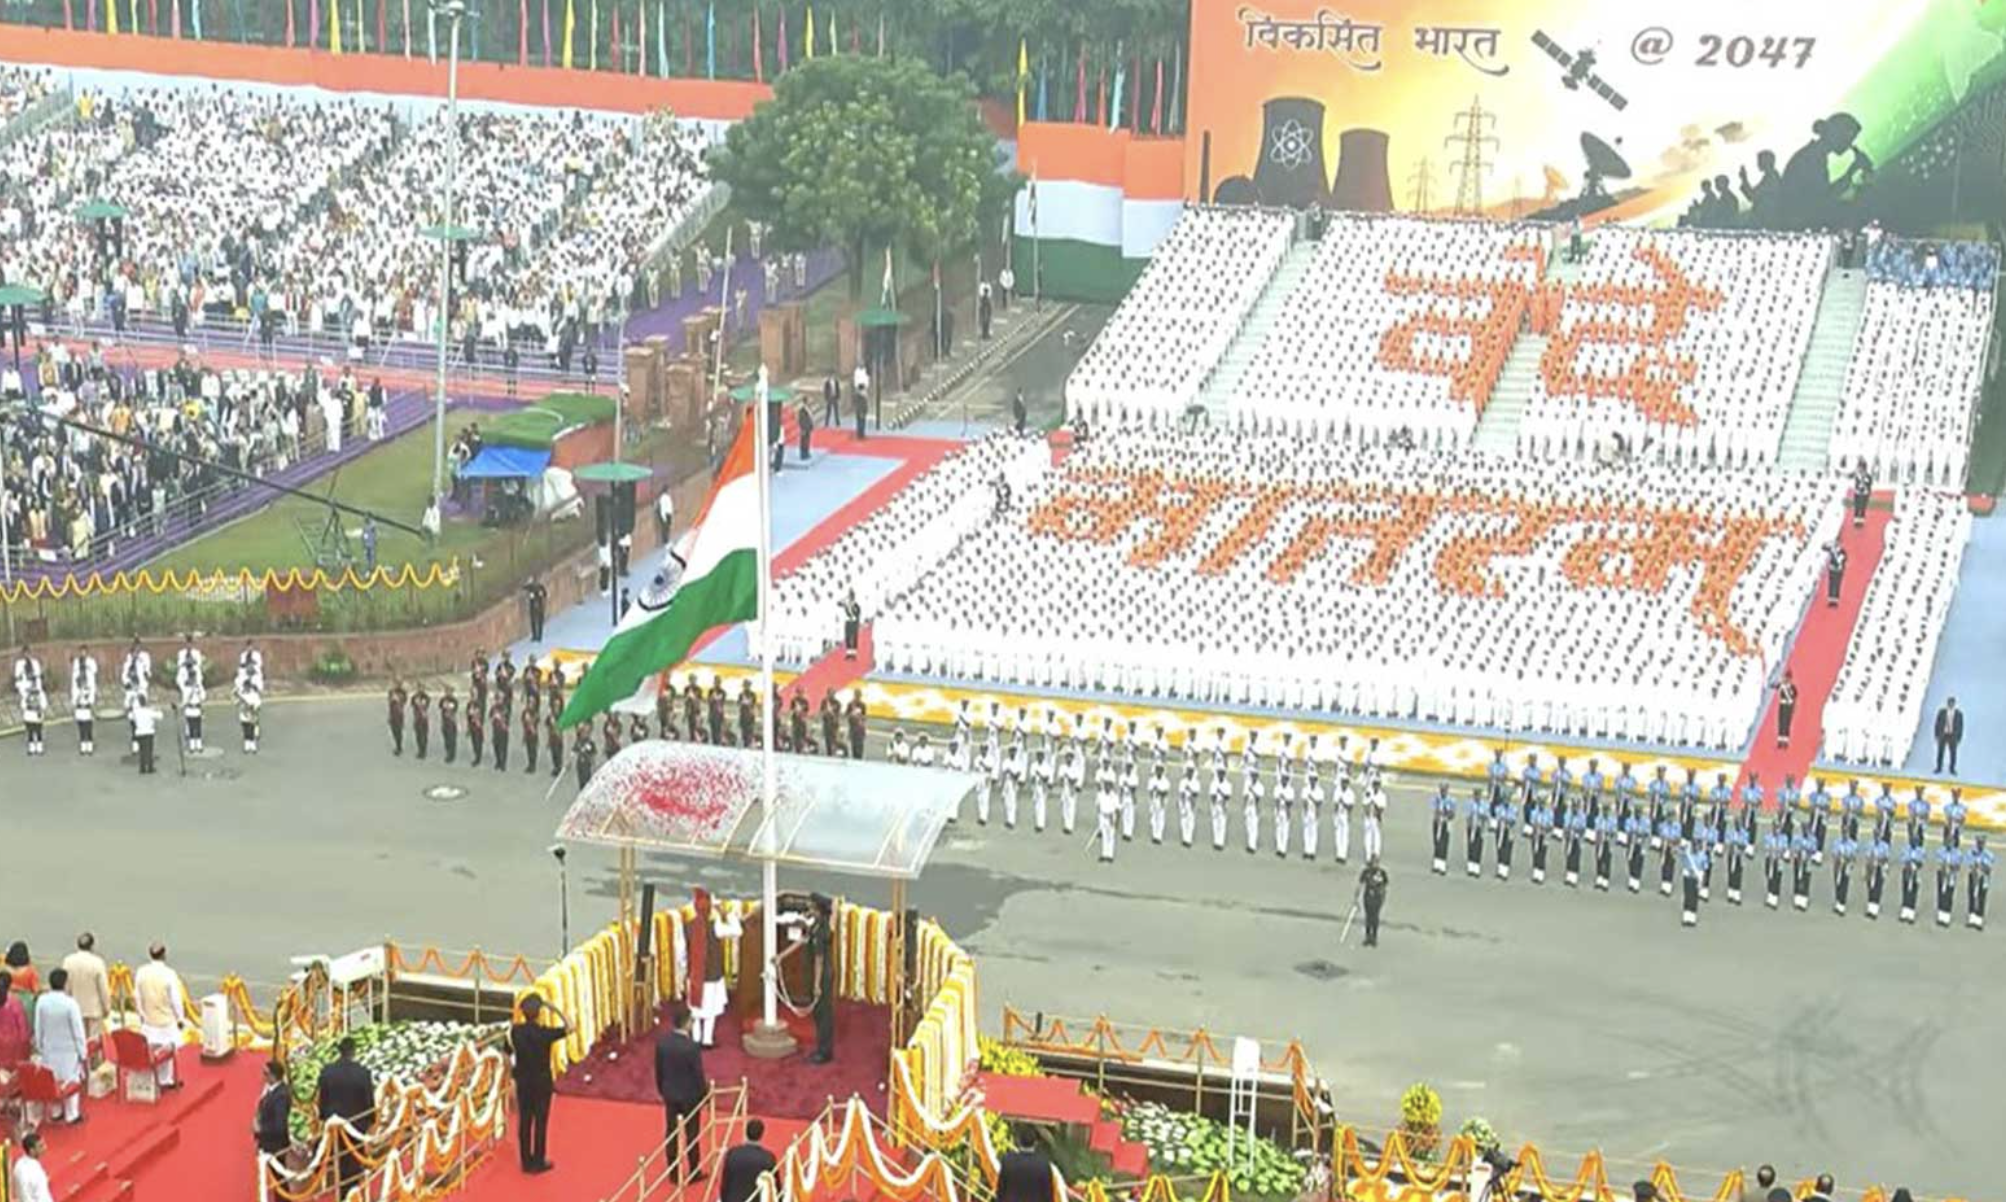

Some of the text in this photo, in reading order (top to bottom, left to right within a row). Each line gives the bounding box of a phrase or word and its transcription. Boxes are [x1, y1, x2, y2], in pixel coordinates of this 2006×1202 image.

[1239, 8, 1816, 76] विकसित भारत @ 2047
